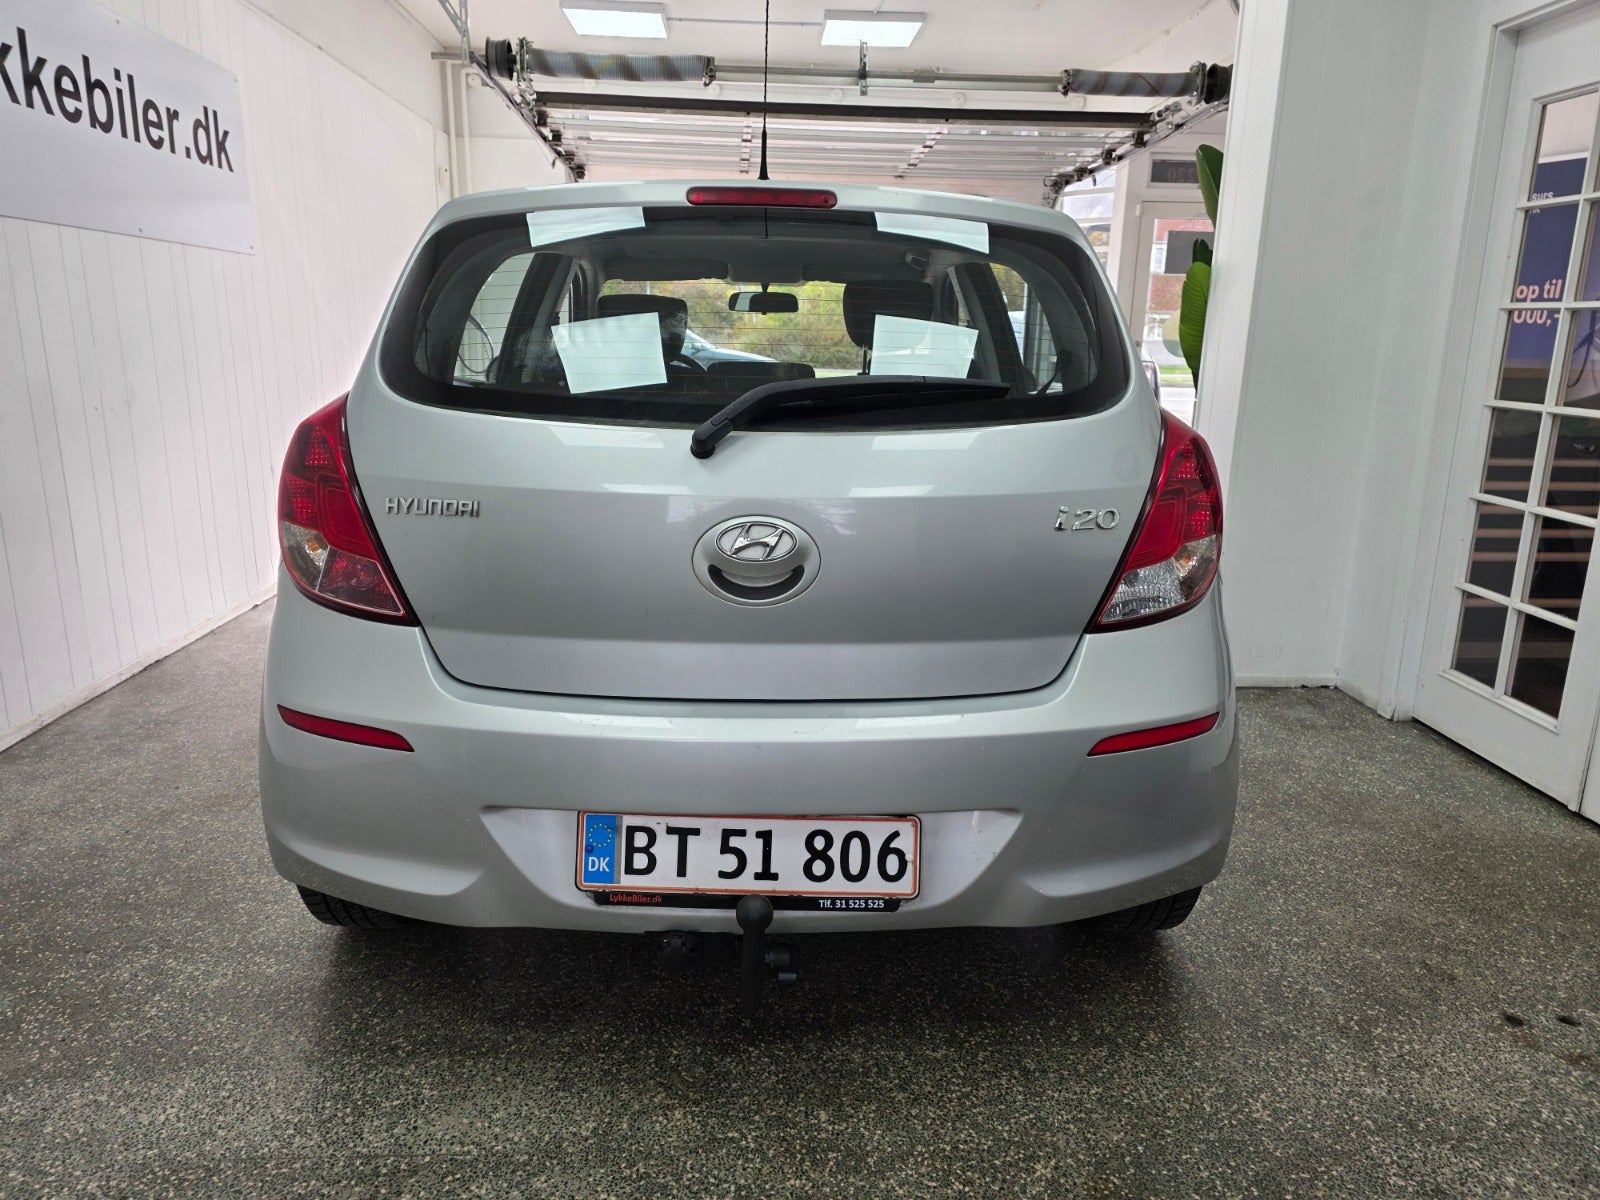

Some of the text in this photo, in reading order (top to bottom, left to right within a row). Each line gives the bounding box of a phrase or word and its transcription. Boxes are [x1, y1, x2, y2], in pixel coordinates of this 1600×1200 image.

[1516, 279, 1562, 303] op til
[385, 497, 480, 517] HYUNDAI
[588, 856, 610, 872] DK
[624, 825, 908, 883] BT 51 806
[819, 899, 885, 909] Tlf. 31 525 525
